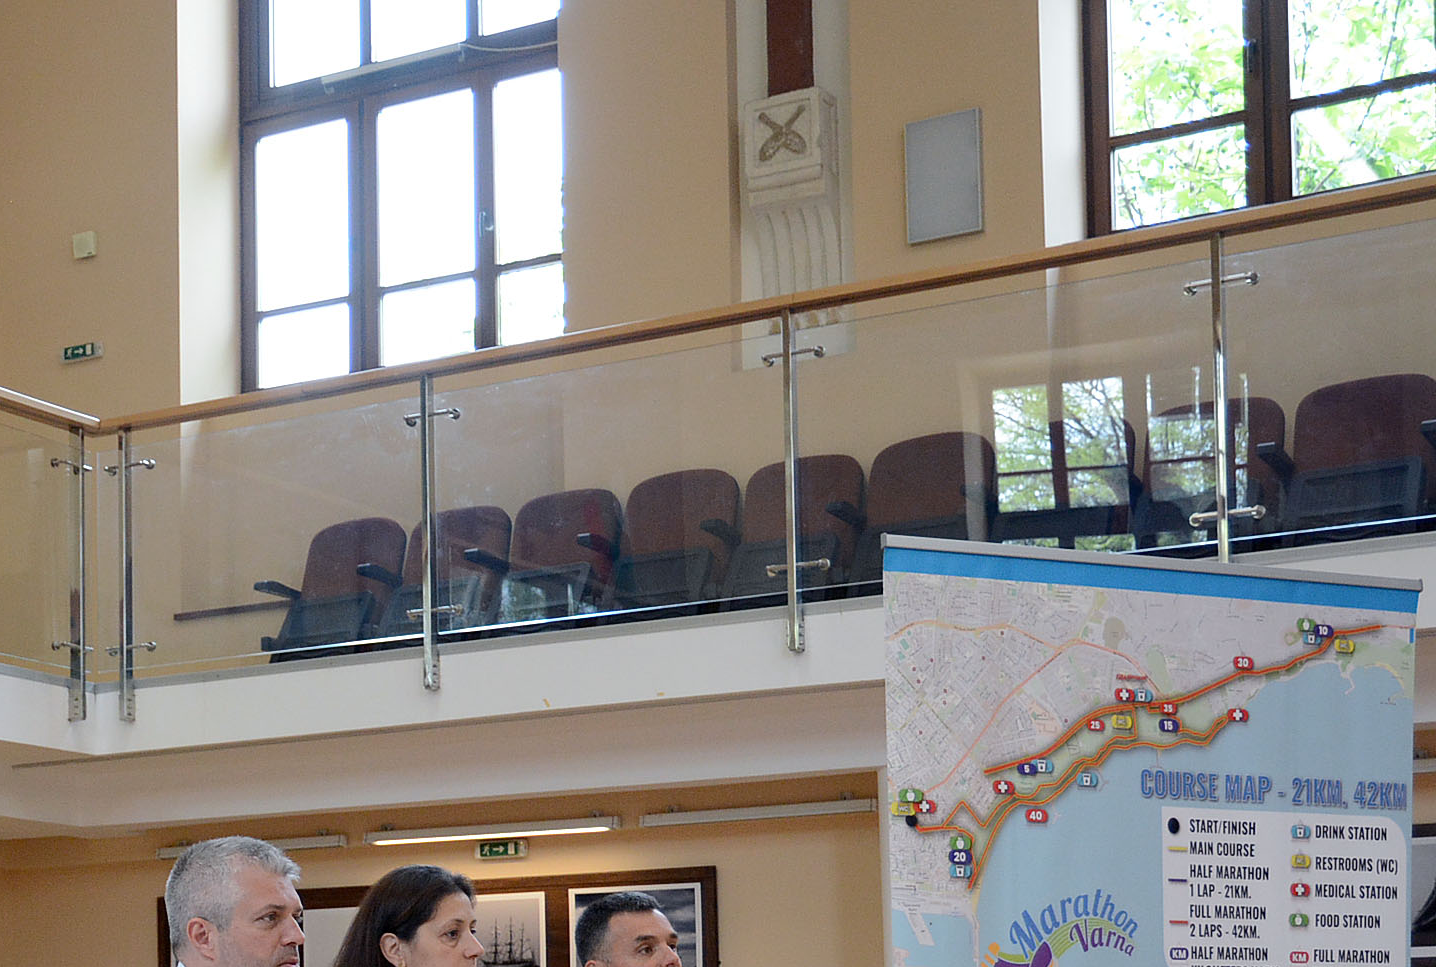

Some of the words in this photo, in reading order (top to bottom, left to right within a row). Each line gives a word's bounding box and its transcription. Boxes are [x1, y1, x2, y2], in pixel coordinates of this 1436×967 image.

[1319, 625, 1330, 635] 10
[1237, 658, 1249, 667] 30
[1090, 721, 1101, 729] 25
[1164, 721, 1174, 731] 15
[1023, 764, 1031, 773] 5
[1140, 768, 1219, 801] COURSE
[1225, 774, 1272, 804] MAP
[1353, 780, 1407, 811] 42KM
[1029, 811, 1043, 821] 40
[1189, 819, 1256, 836] START/FINISH
[1315, 825, 1345, 840] DRINK
[1347, 826, 1387, 841] STATION
[1189, 841, 1214, 856] MAIN
[1216, 842, 1256, 857] COURSE
[953, 852, 966, 862] 20
[1189, 864, 1214, 879] HALF
[1215, 866, 1270, 881] MARATHON
[1315, 856, 1373, 872] RESTROOMS
[1376, 858, 1398, 875] (WC)
[1189, 884, 1194, 897] 1
[1197, 884, 1215, 897] LAP
[1224, 885, 1252, 899] 21KM.
[1315, 883, 1356, 898] MEDICAL
[1359, 884, 1398, 900] STATION
[1189, 905, 1212, 919] FULL
[1214, 905, 1267, 920] MARATHON
[1009, 889, 1139, 960] Marathon
[1315, 913, 1340, 928] FOOD
[1341, 914, 1381, 929] STATION
[1069, 919, 1135, 956] Varna
[1189, 924, 1196, 937] 2
[1198, 924, 1223, 938] LAPS
[1232, 925, 1260, 939] 42KM.
[1172, 949, 1187, 959] KM
[1191, 947, 1214, 961] HALF
[1216, 947, 1268, 961] MARATHON
[1292, 953, 1307, 962] KM
[1313, 949, 1337, 962] FULL
[1338, 949, 1390, 964] MARATHON
